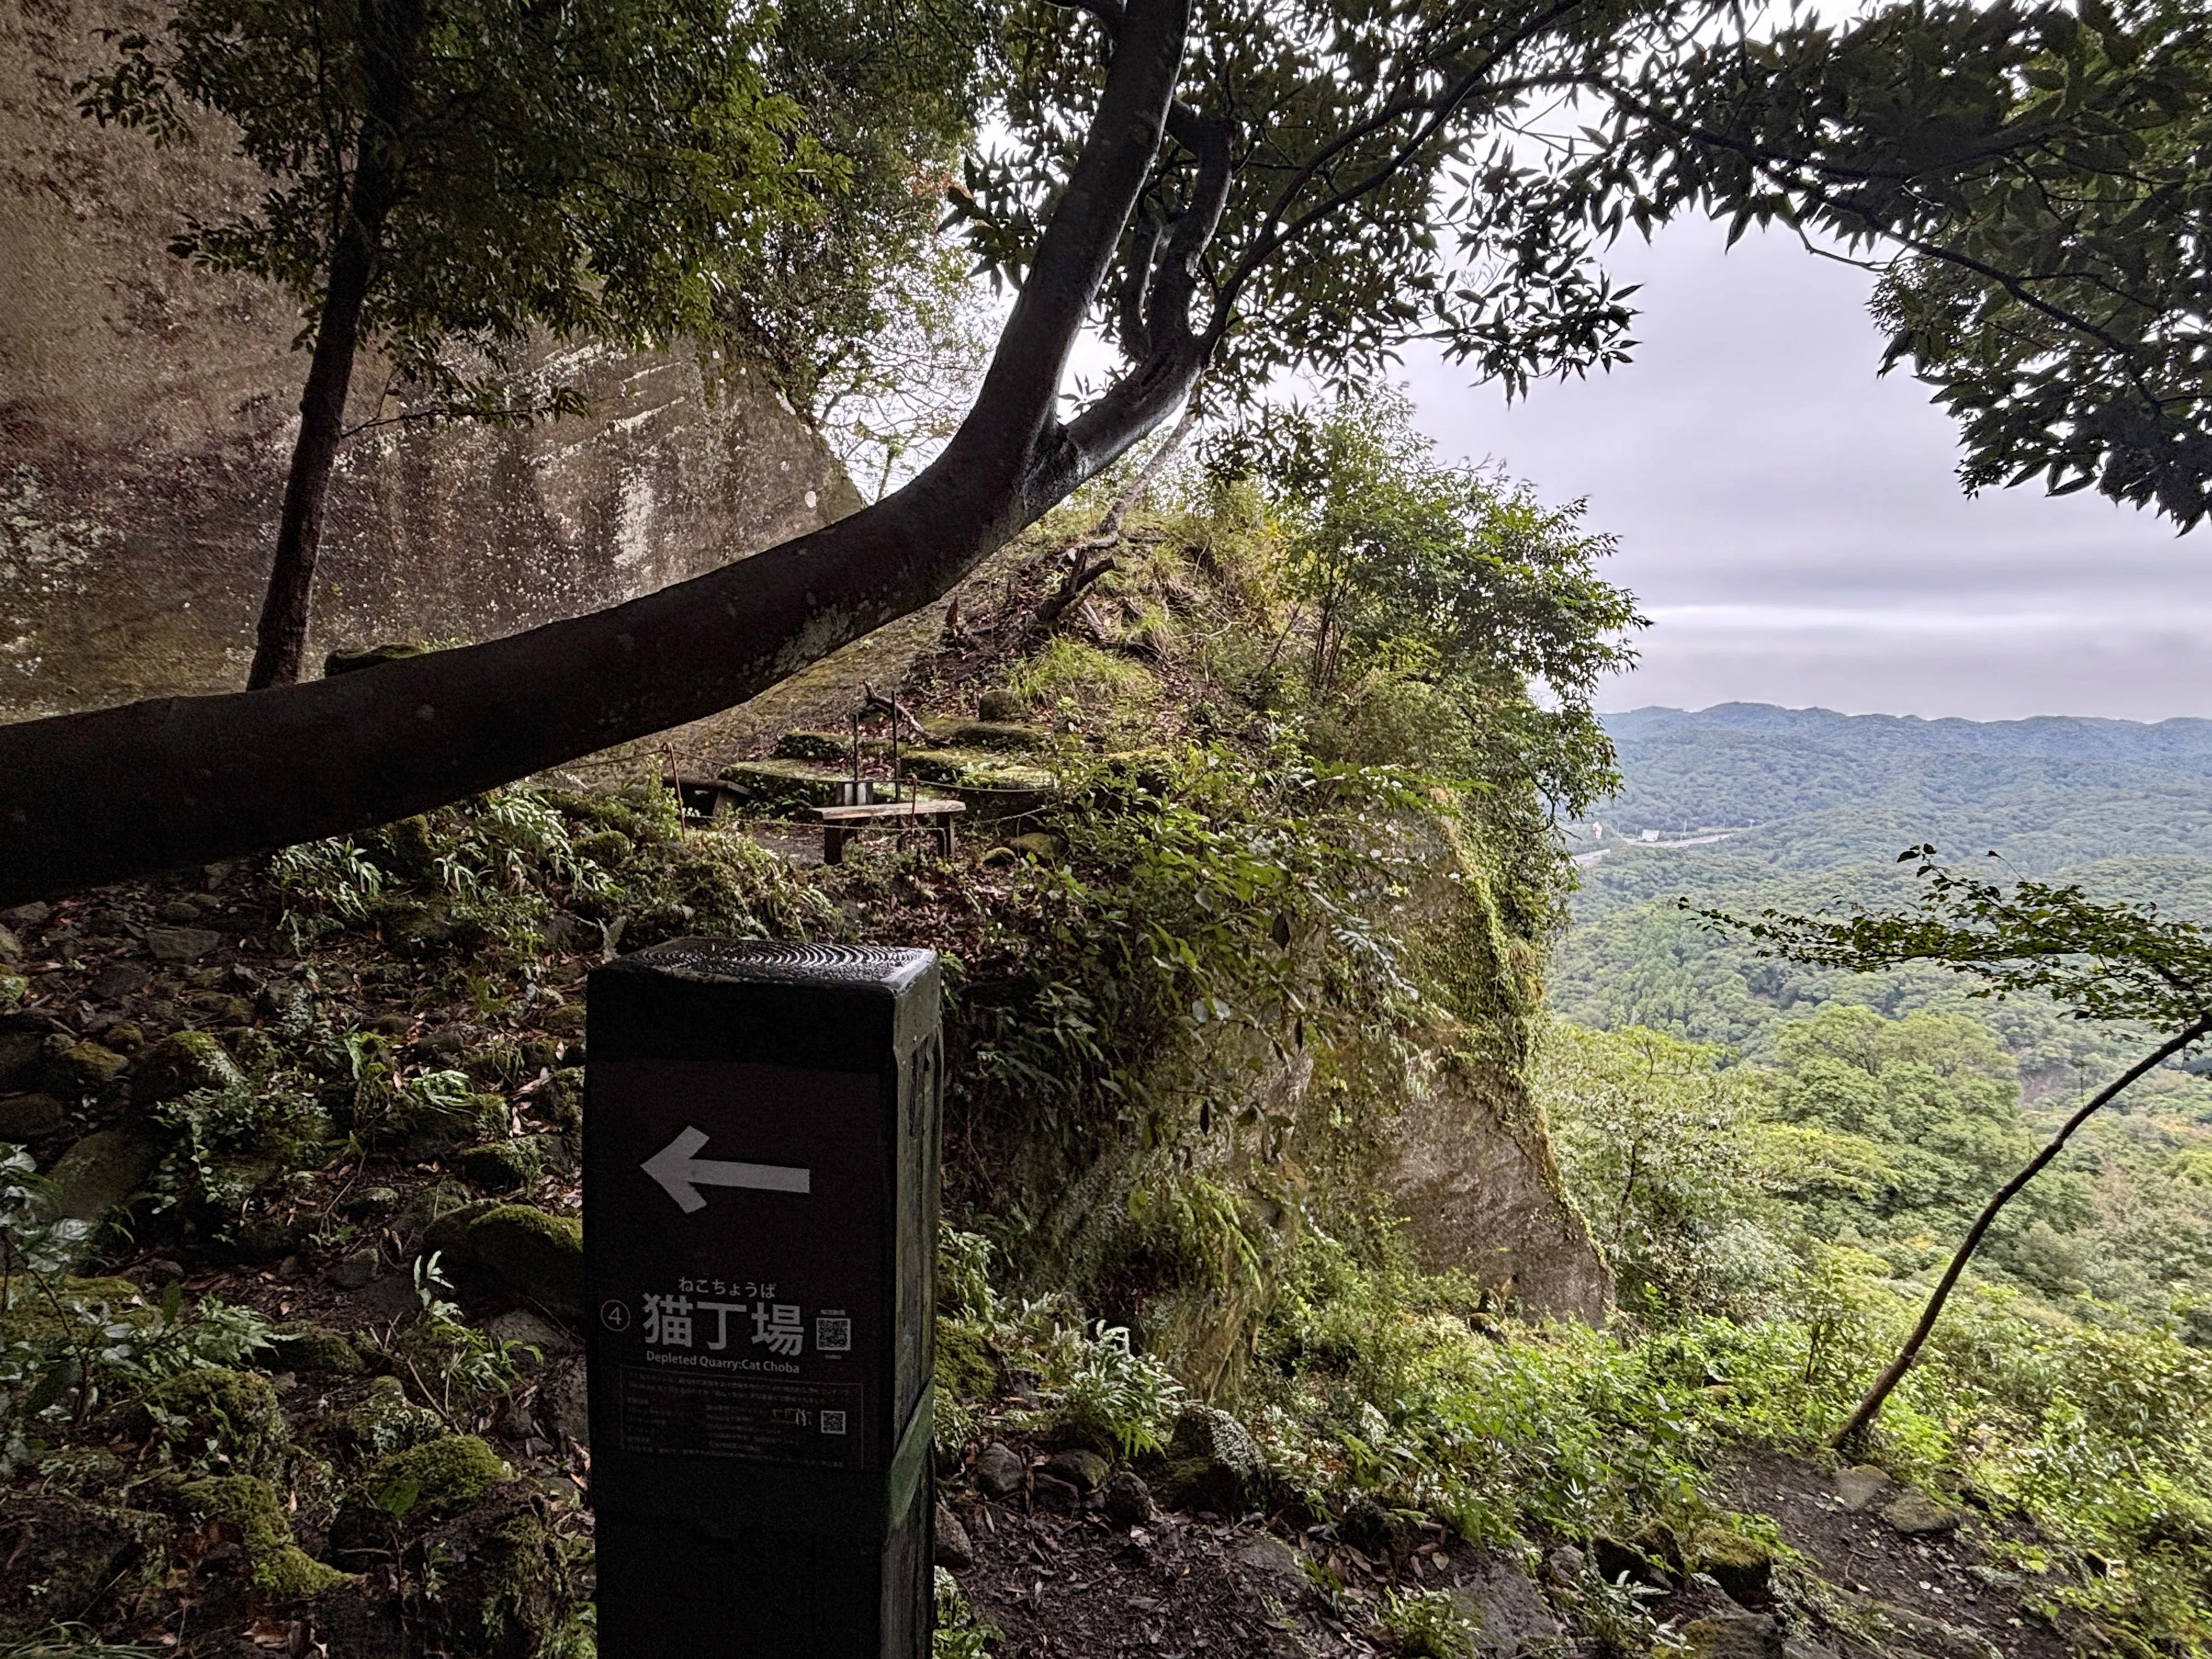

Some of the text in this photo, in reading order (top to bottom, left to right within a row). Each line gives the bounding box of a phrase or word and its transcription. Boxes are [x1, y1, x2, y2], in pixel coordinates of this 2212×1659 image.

[679, 1277, 776, 1299] ねこちょうば
[642, 1293, 804, 1356] 猫丁場
[647, 1350, 697, 1365] Depleted
[763, 1361, 800, 1373] Choba
